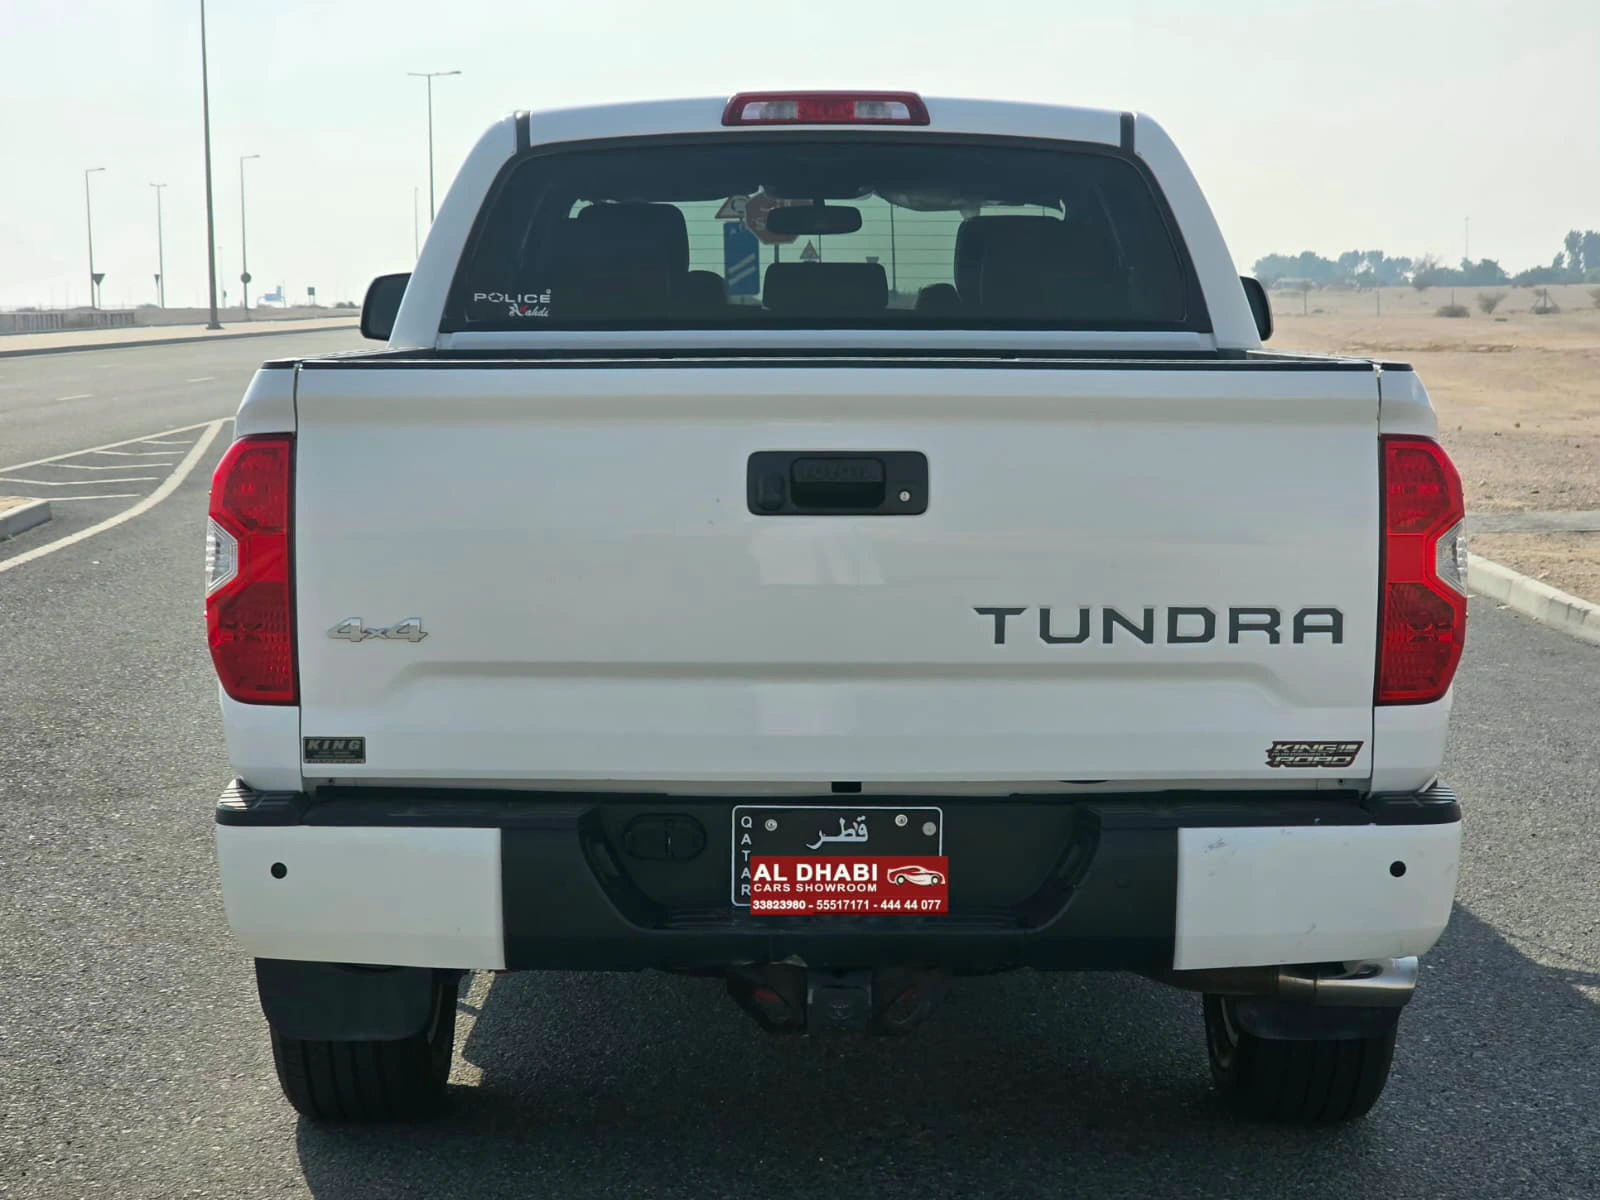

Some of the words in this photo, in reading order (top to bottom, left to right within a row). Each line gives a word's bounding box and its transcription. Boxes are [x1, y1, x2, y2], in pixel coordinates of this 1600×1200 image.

[973, 607, 1343, 644] TUNDRA
[306, 739, 362, 750] KING
[805, 815, 869, 850] قطر
[740, 815, 752, 896] QATAR
